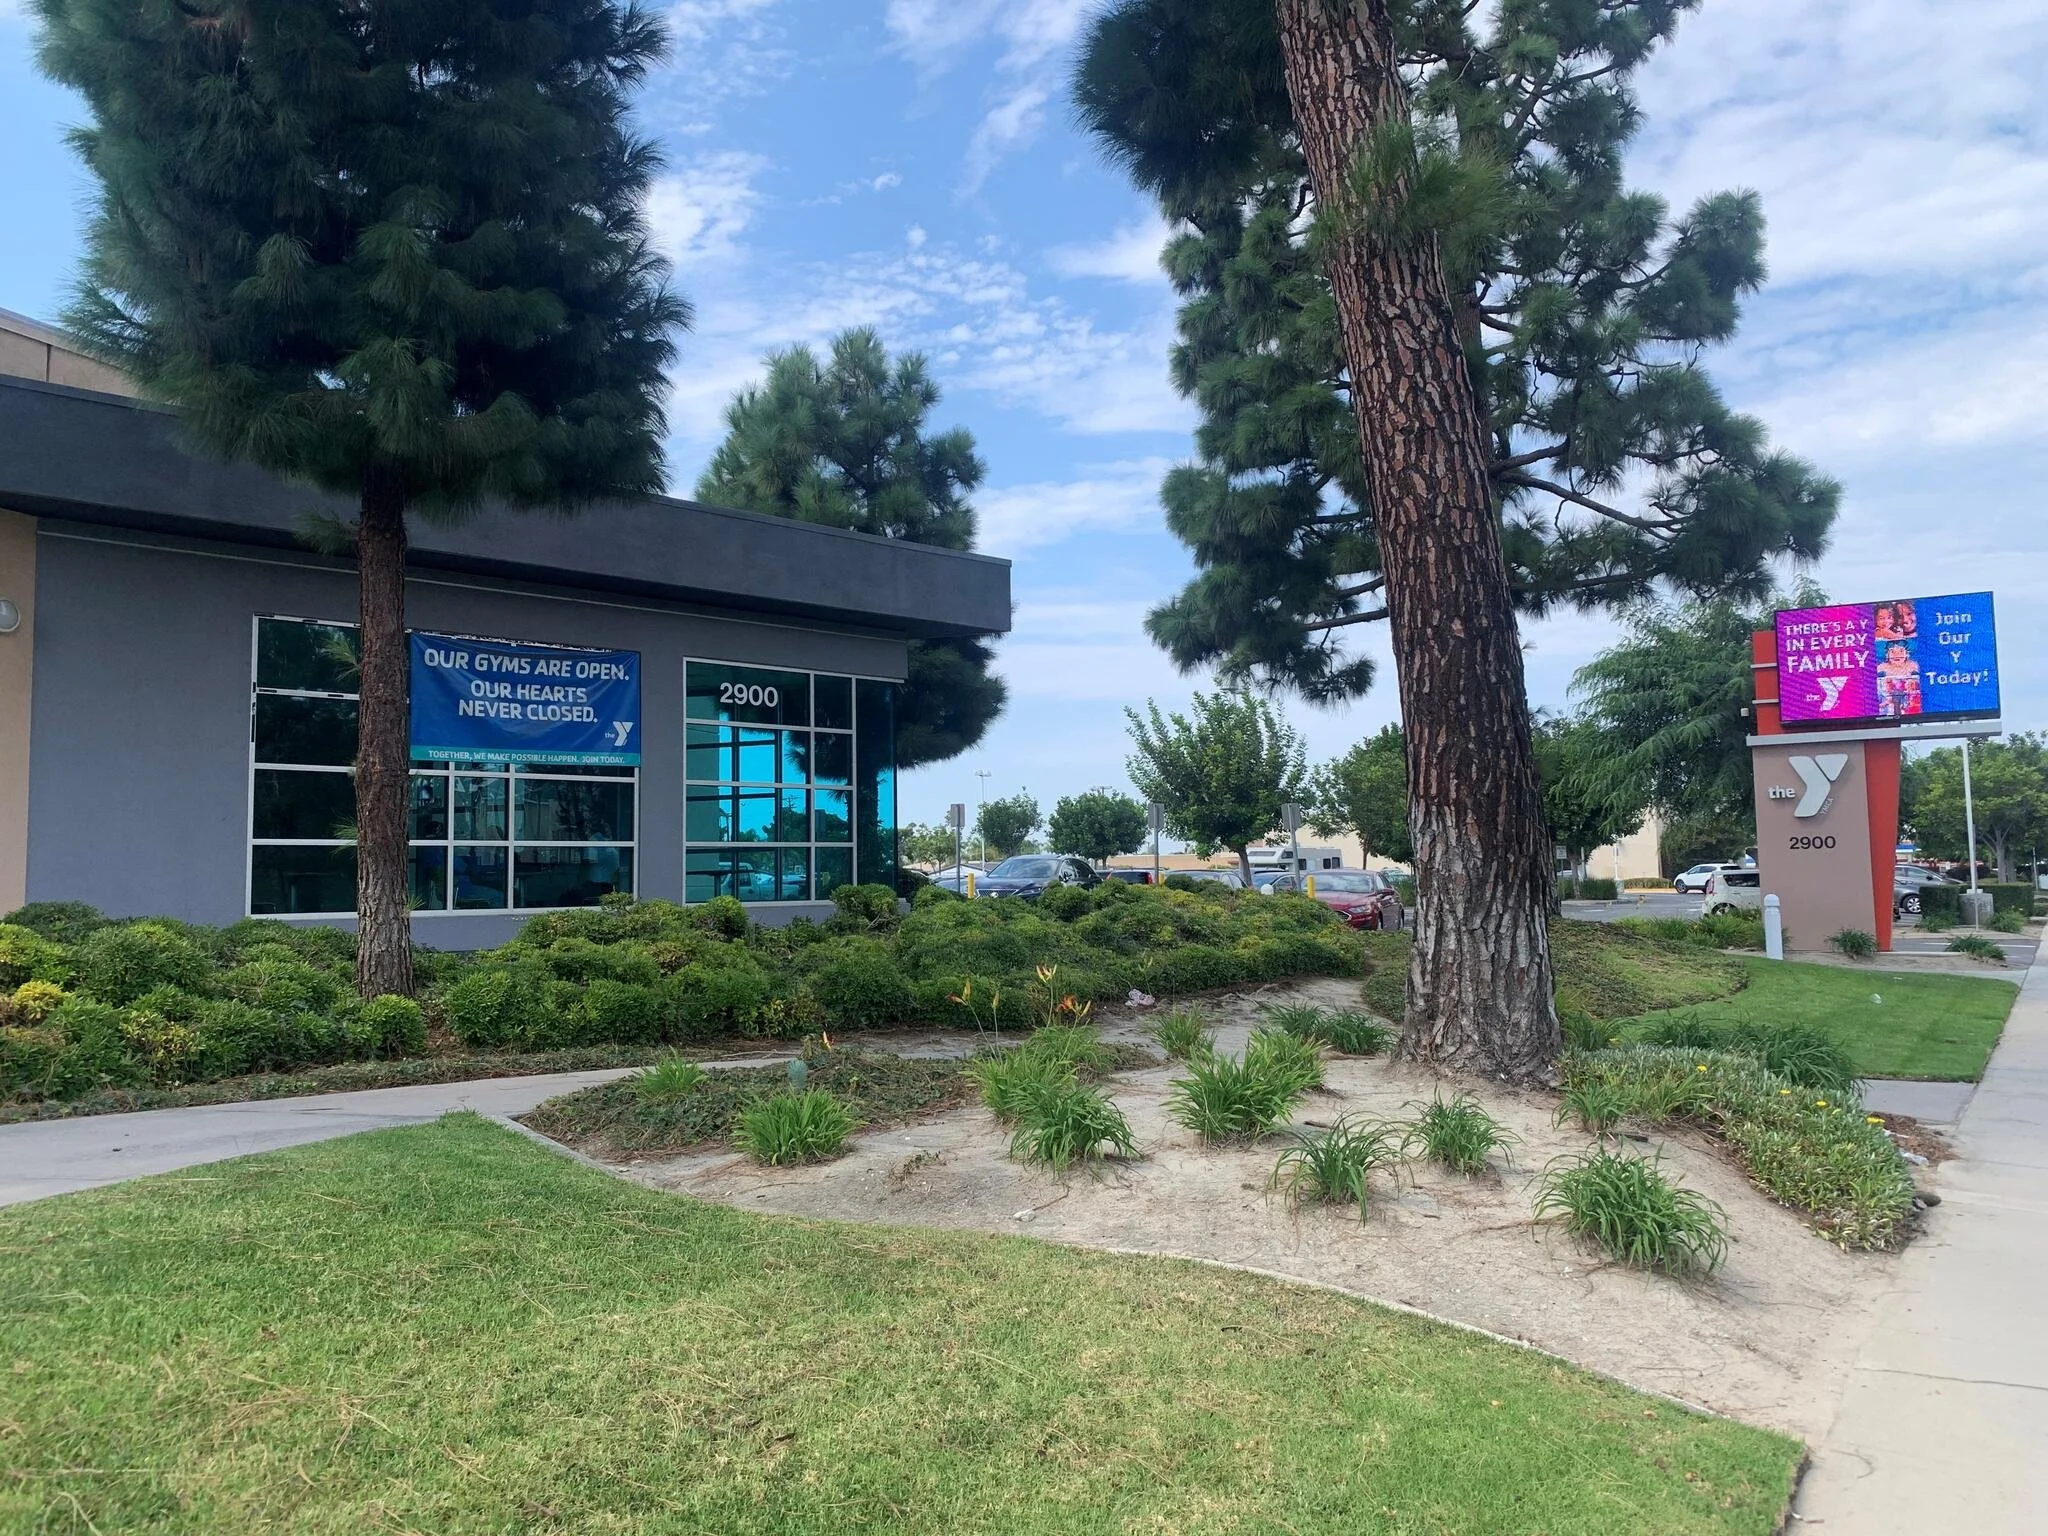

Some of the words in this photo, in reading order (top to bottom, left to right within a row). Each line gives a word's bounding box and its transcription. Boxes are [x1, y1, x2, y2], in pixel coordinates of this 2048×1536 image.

[1935, 611, 1972, 625] Join
[1784, 621, 1841, 636] THERE'S
[1845, 620, 1855, 632] A
[1859, 619, 1870, 631] Y
[1786, 637, 1804, 652] IN
[1810, 633, 1868, 651] EVERY
[1938, 631, 1972, 645] Our
[424, 648, 469, 670] OUR
[475, 653, 531, 675] GYMS
[534, 660, 573, 679] ARE
[575, 661, 630, 681] OPEN.
[1787, 650, 1870, 673] FAMILY
[1950, 650, 1961, 664] Y
[1926, 669, 1989, 688] Today!
[471, 679, 512, 699] OUR
[516, 683, 588, 703] HEARTS
[720, 683, 778, 707] 2900
[458, 699, 523, 720] NEVER
[526, 704, 599, 723] CLOSED.
[428, 750, 472, 761] TOGETHER,
[473, 752, 487, 761] WE
[487, 752, 510, 762] MAKE
[511, 753, 547, 763] POSSIBLE
[547, 754, 578, 763] HAPPEN.
[581, 755, 600, 764] JOIN
[600, 755, 625, 764] TODAY.
[1767, 785, 1796, 799] the
[1789, 836, 1836, 850] 2900
